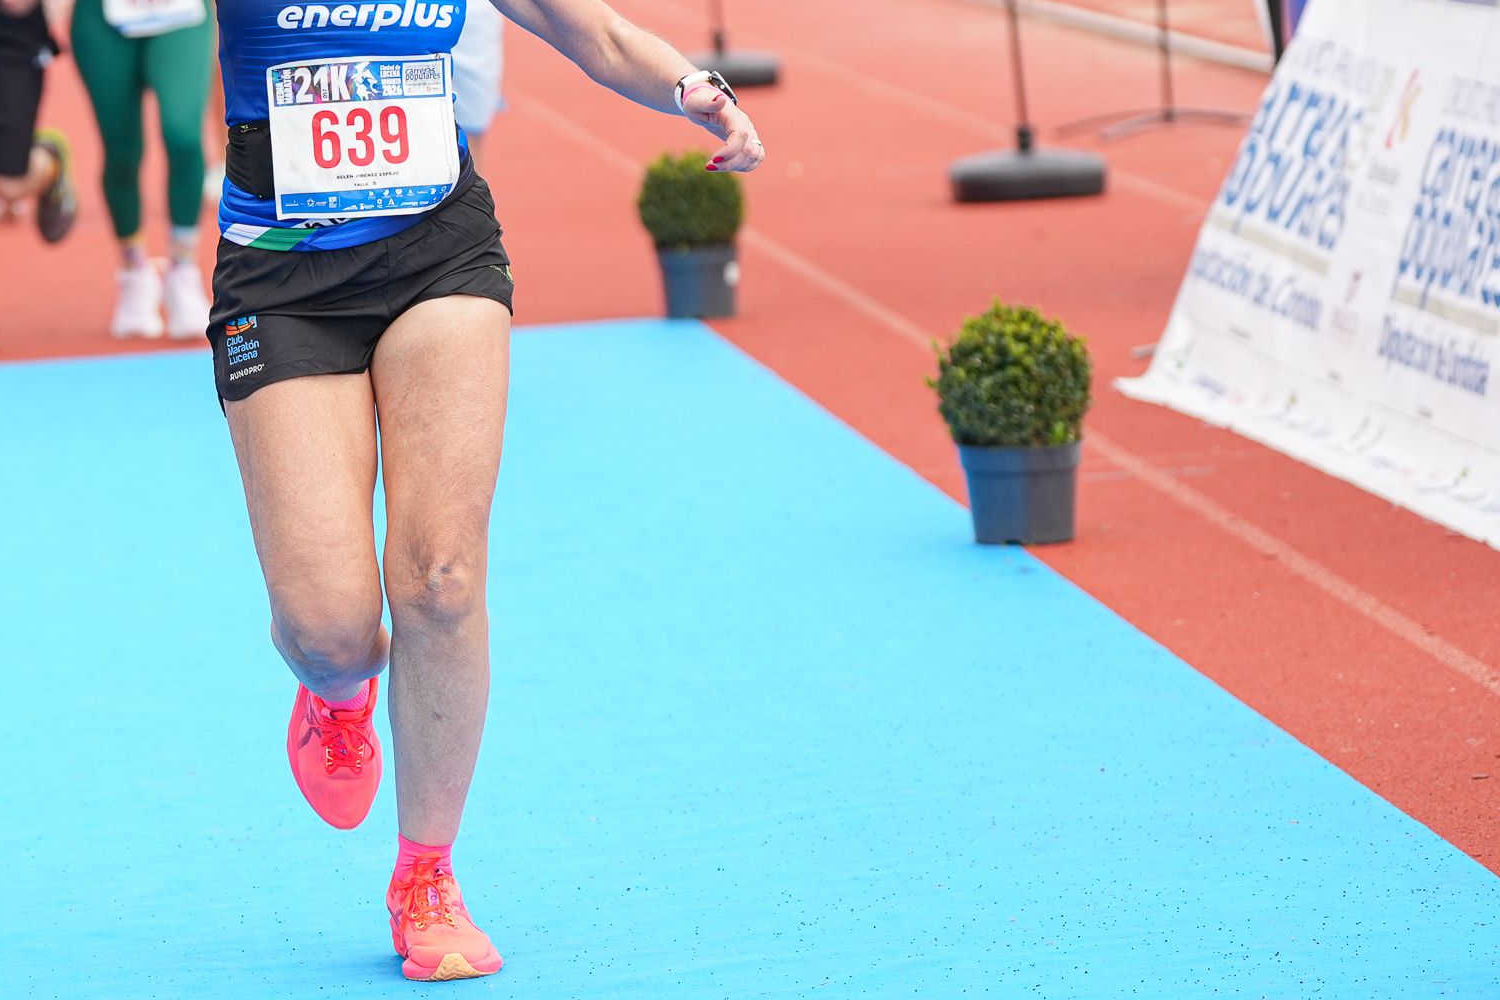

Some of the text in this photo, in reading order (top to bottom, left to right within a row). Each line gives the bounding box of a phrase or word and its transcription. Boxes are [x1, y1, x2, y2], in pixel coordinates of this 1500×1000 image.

[406, 67, 436, 75] carreras
[406, 72, 441, 82] populares
[294, 64, 352, 104] 21K
[382, 84, 403, 96] 2026
[312, 106, 410, 169] 639
[226, 335, 244, 348] Club
[228, 340, 260, 356] Maratón
[229, 351, 258, 366] Lucena
